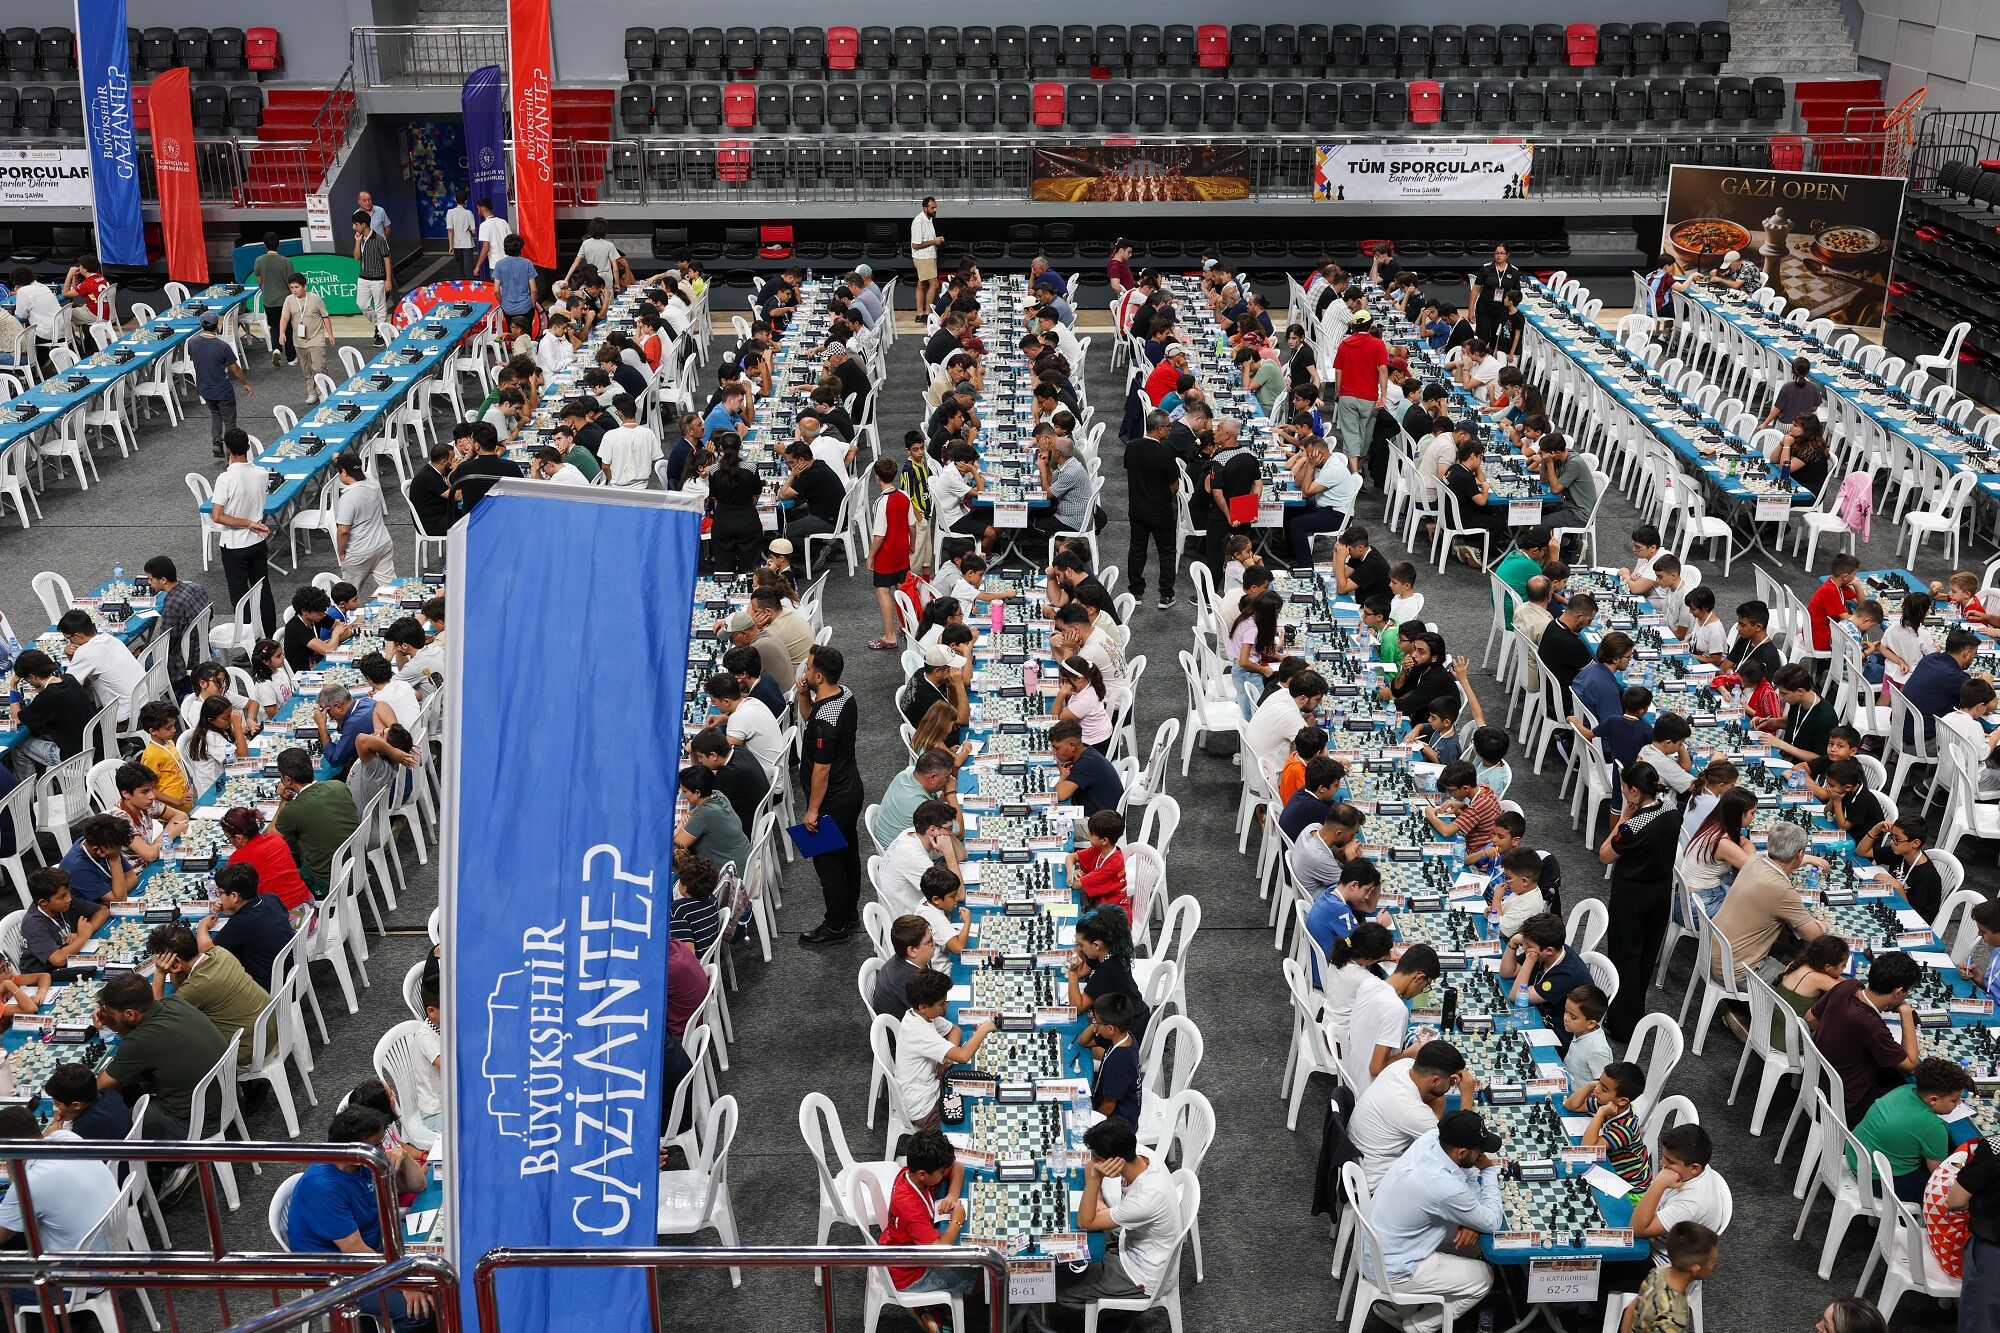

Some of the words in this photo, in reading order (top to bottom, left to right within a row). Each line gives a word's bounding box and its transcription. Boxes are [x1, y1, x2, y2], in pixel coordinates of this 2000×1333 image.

[98, 85, 114, 158] BÜYÜKŞEHİR
[108, 66, 134, 178] GAZİANTEP
[524, 88, 535, 160] BÜYÜKŞEHİR
[534, 68, 550, 181] GAZİANTEP
[0, 167, 89, 178] PORCULAR
[1348, 159, 1384, 174] TÜM
[1390, 162, 1505, 174] SPORCULARA
[1720, 176, 1776, 198] GAZİ
[1782, 180, 1848, 202] OPEN
[306, 274, 340, 284] KŞEHİR
[310, 284, 356, 298] ANTEP
[520, 918, 572, 1178] BÜYÜKŞEHİR
[565, 844, 654, 1236] GAZİANTEP
[1009, 1288, 1036, 1296] 8-61
[1547, 1285, 1579, 1294] 62-75
